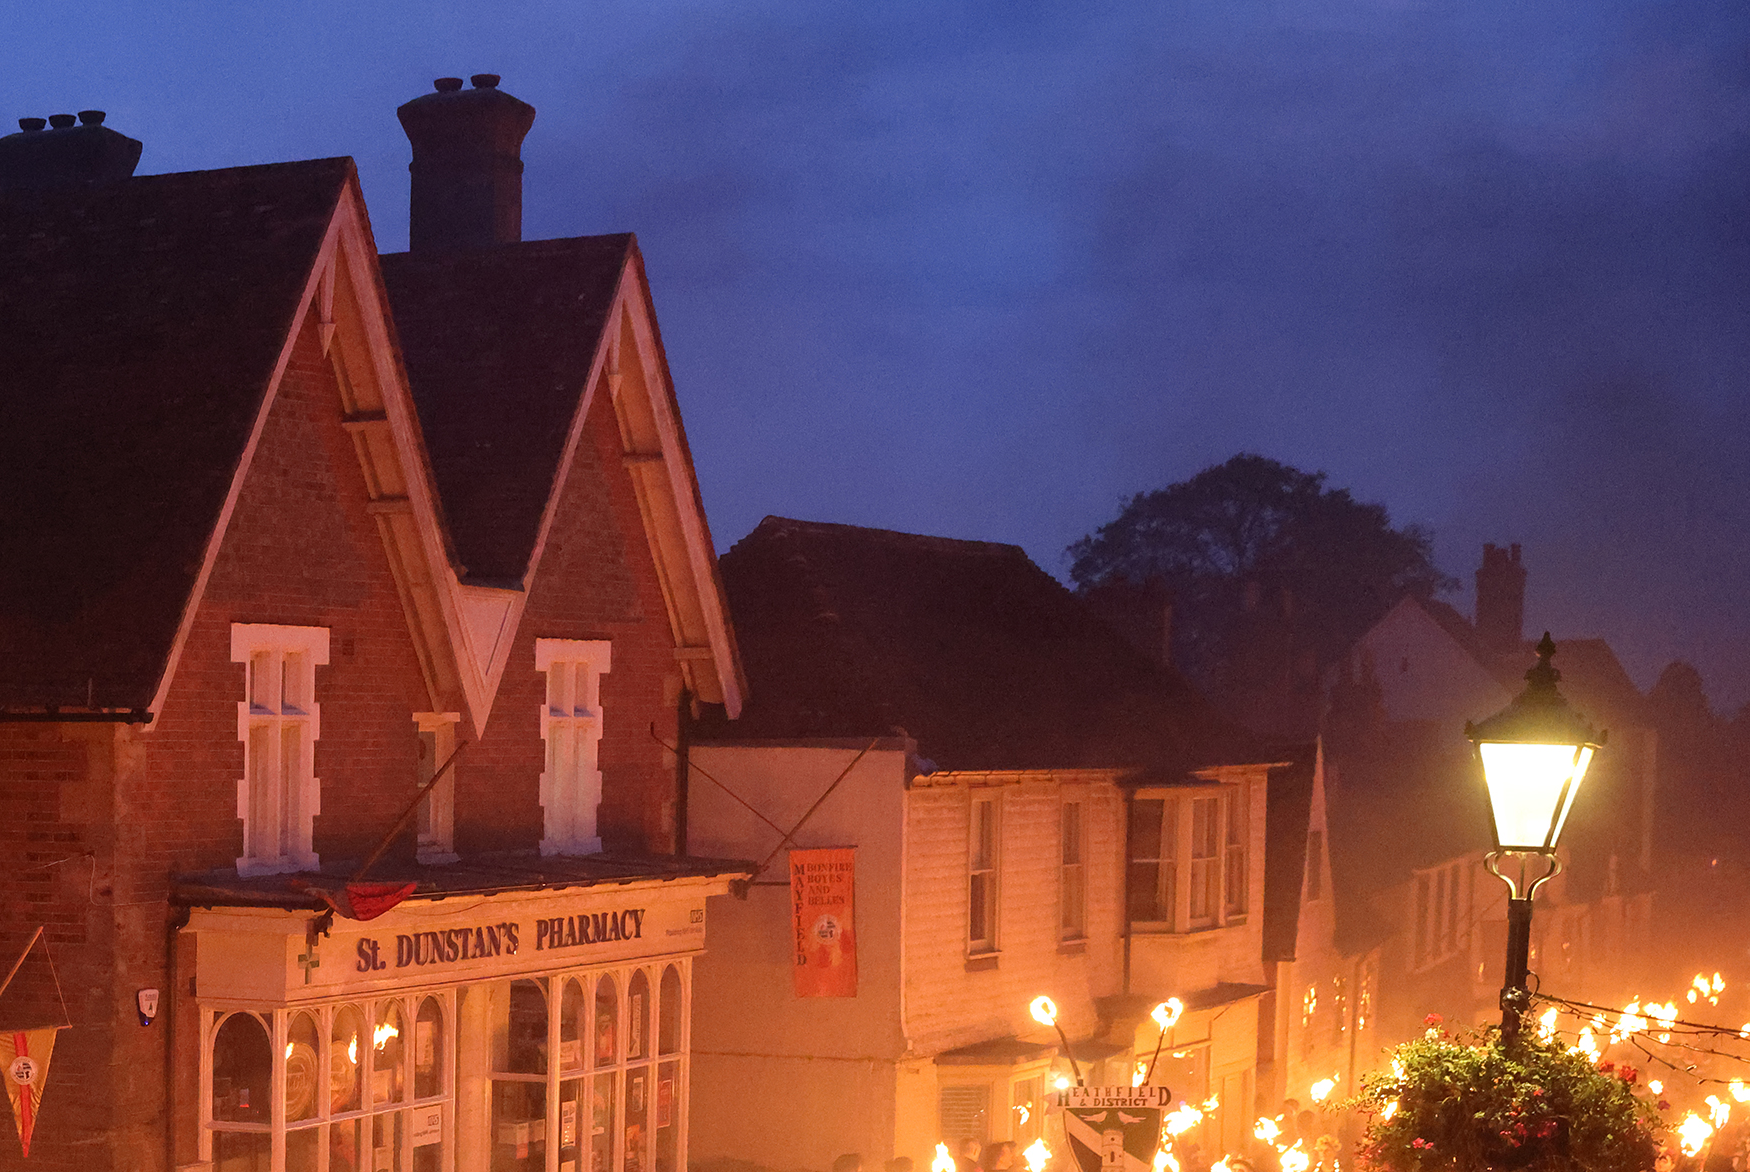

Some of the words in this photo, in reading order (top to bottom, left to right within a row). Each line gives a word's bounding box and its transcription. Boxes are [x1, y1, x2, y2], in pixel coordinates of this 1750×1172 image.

[807, 863, 852, 872] BONFIRE
[807, 874, 842, 883] BOYES
[810, 885, 830, 895] AND
[808, 896, 845, 905] BELLES
[794, 864, 807, 966] MAYFIELD
[356, 937, 387, 973] St.
[396, 921, 519, 968] DUNSTAN'S
[536, 903, 646, 951] PHARMACY
[1056, 1086, 1172, 1107] HEATHFIELD
[1093, 1097, 1148, 1107] DISTRICT
